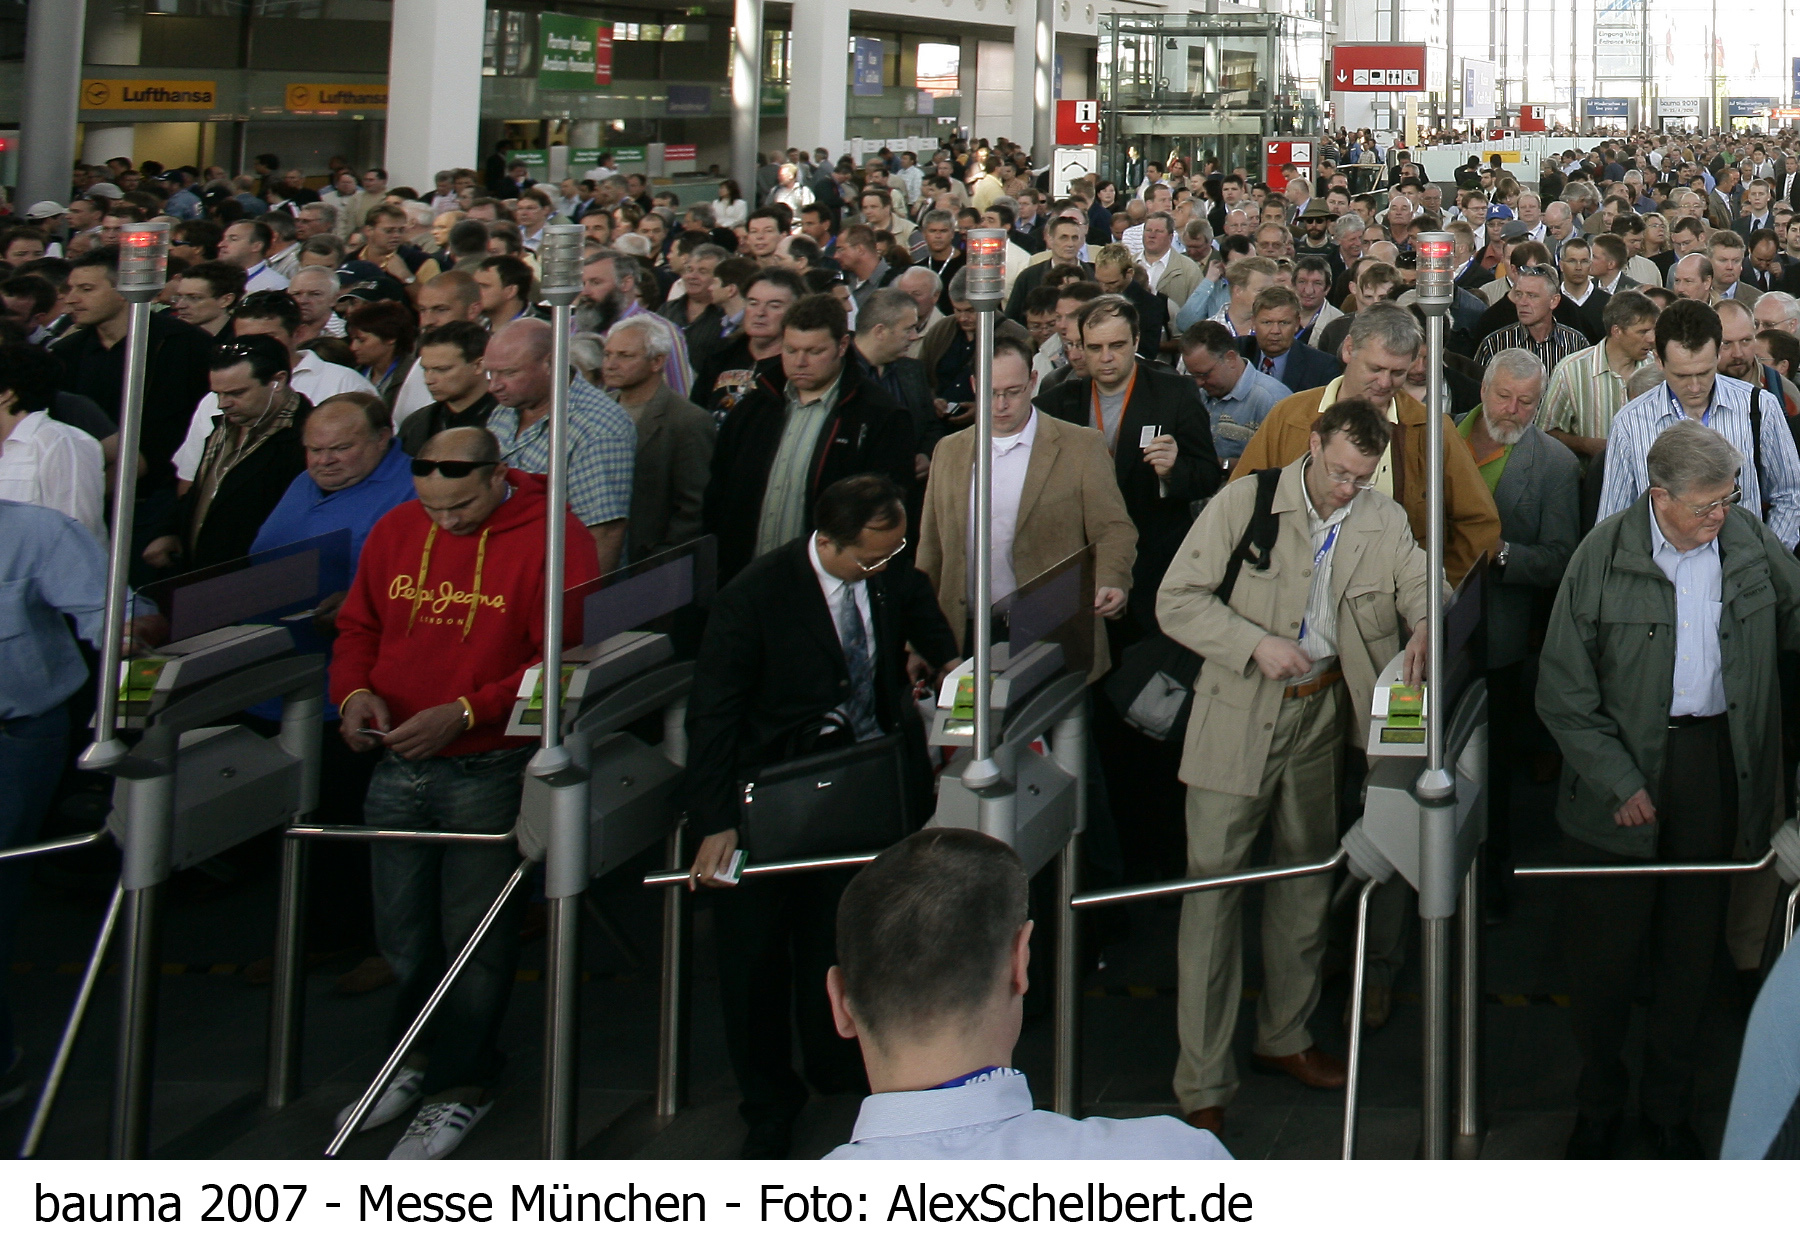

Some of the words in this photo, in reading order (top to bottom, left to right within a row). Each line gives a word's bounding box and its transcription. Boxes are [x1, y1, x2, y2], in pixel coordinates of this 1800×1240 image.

[122, 86, 213, 104] Lufthansa
[1660, 98, 1681, 106] bauma
[432, 581, 507, 614] Jeans
